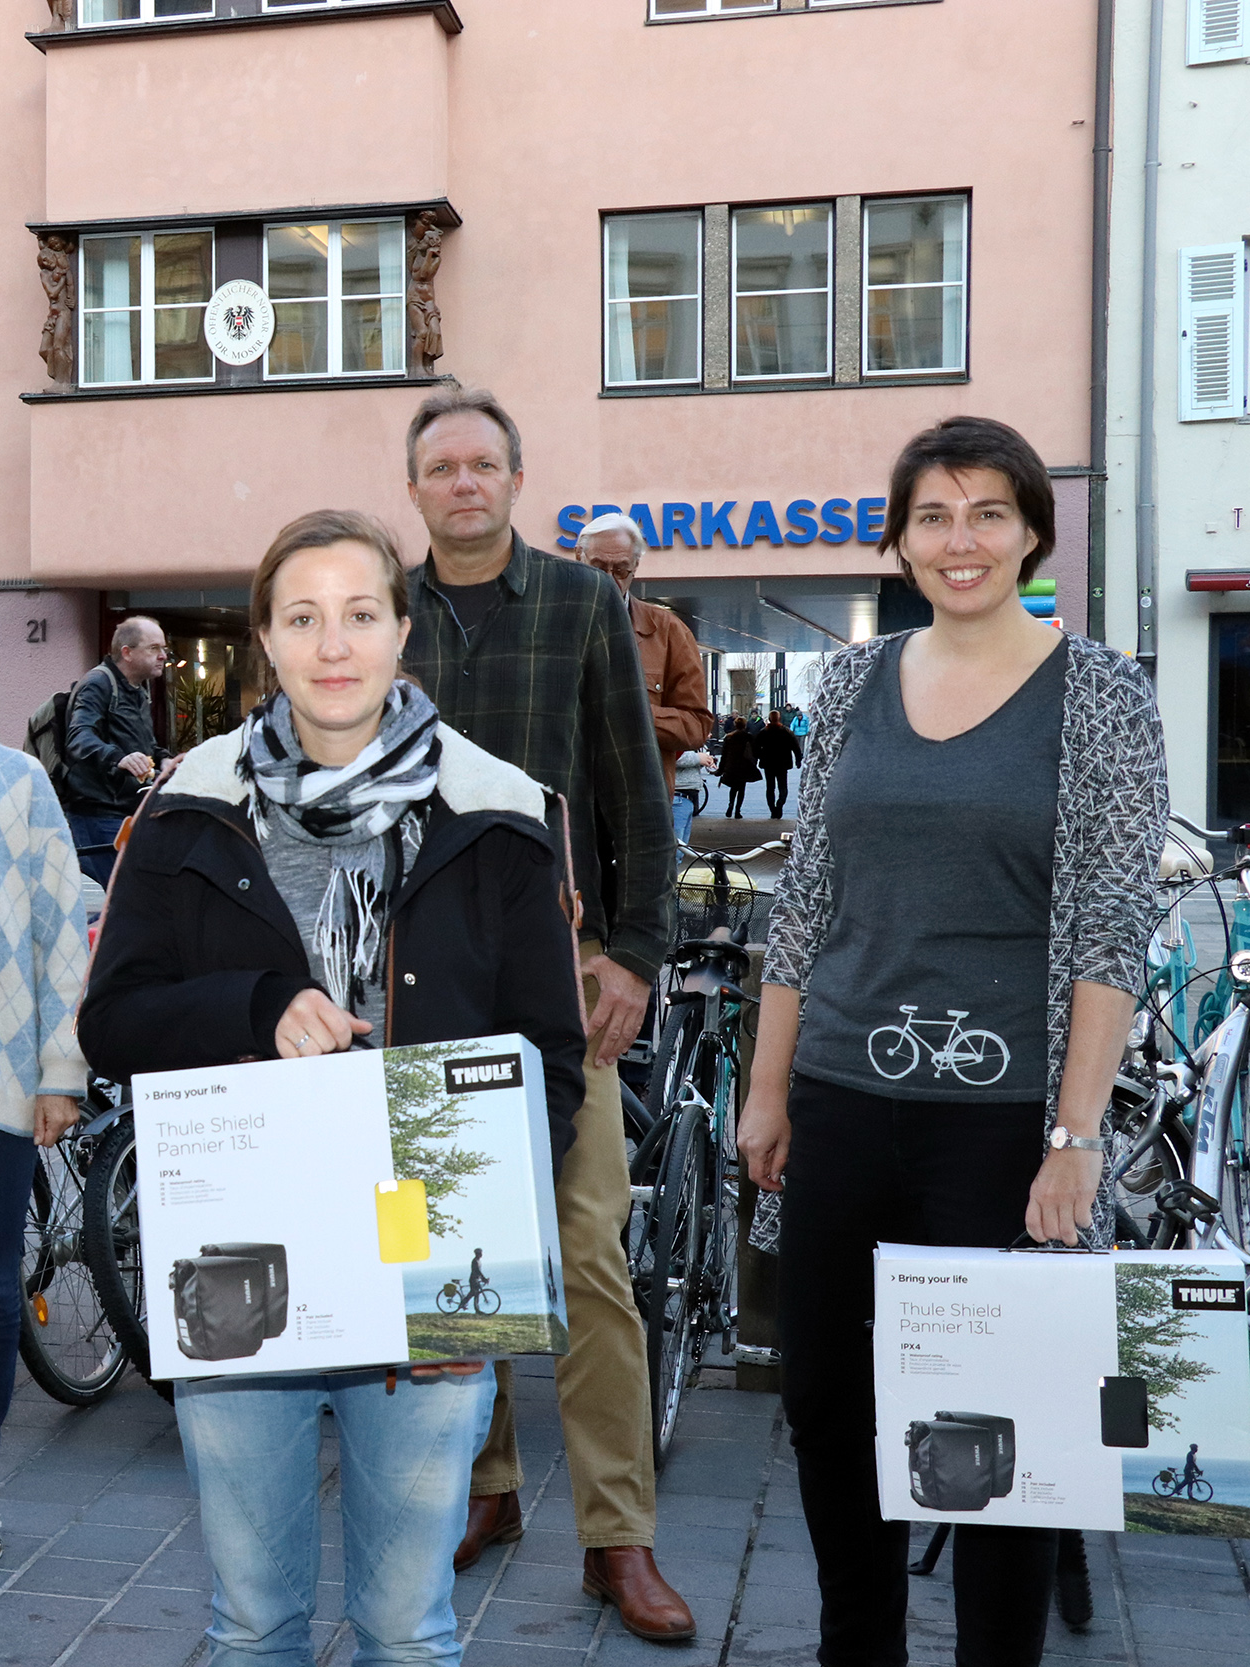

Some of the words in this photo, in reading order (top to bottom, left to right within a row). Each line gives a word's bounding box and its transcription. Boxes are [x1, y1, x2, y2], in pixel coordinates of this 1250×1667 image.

[257, 297, 269, 333] NOTAR
[215, 340, 229, 357] DR.
[232, 339, 264, 360] MOSER
[26, 618, 47, 643] 21
[451, 1062, 513, 1085] THULE
[153, 1090, 182, 1101] Bring
[184, 1087, 208, 1099] your
[211, 1084, 227, 1095] life
[156, 1120, 205, 1138] Thule
[210, 1113, 265, 1133] Shield
[1197, 1085, 1218, 1154] KTM
[157, 1138, 225, 1157] Pannier
[231, 1135, 259, 1150] 13L
[159, 1169, 181, 1178] IPX4
[898, 1274, 925, 1284] Bring
[928, 1275, 950, 1284] your
[953, 1275, 968, 1283] life
[1178, 1287, 1236, 1303] THULE
[296, 1303, 308, 1312] x2
[900, 1302, 945, 1316] Thule
[950, 1303, 1002, 1318] Shield
[900, 1319, 962, 1334] Pannier
[968, 1320, 995, 1335] 13L
[1021, 1471, 1032, 1479] x2
